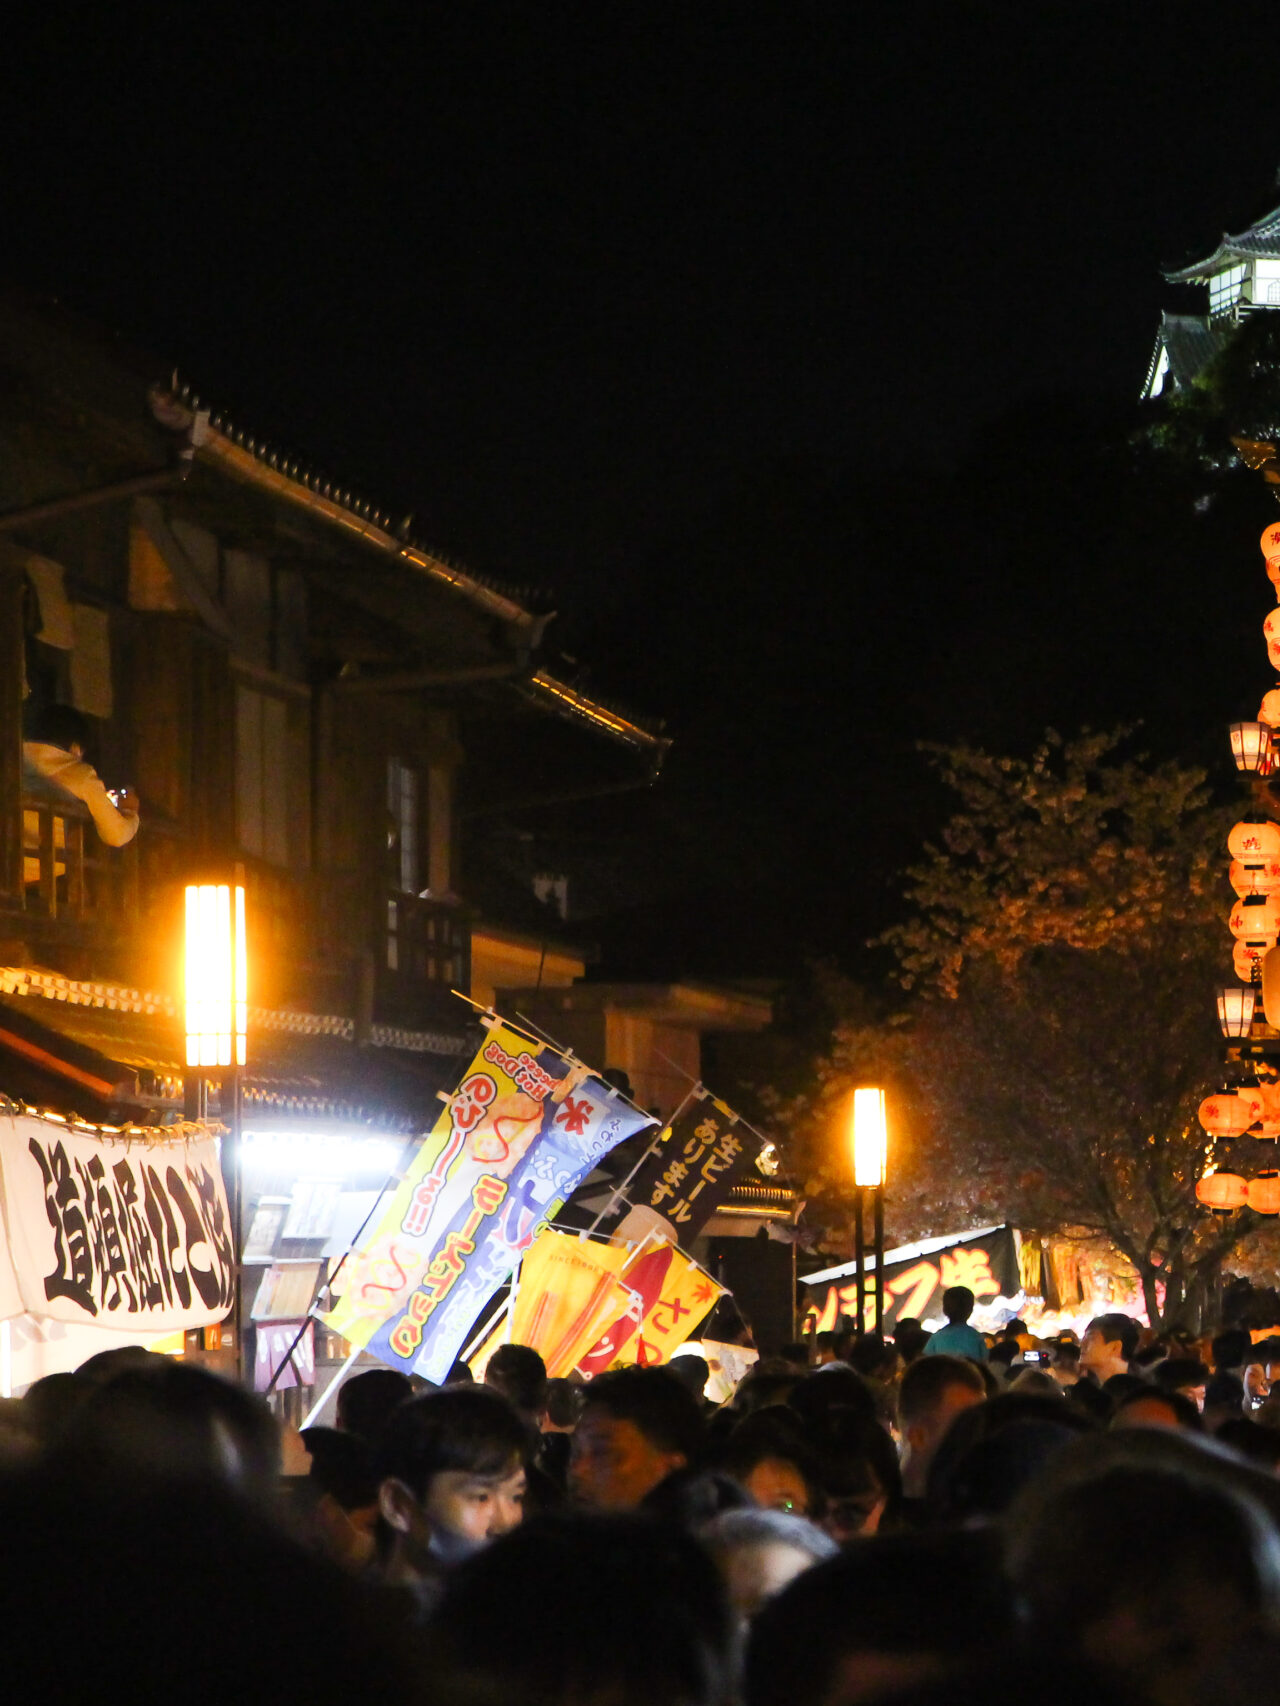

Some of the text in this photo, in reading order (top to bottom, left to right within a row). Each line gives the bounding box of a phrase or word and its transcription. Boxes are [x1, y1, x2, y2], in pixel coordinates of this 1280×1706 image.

[650, 1117, 720, 1206] あります
[667, 1132, 743, 1224] 生ビール
